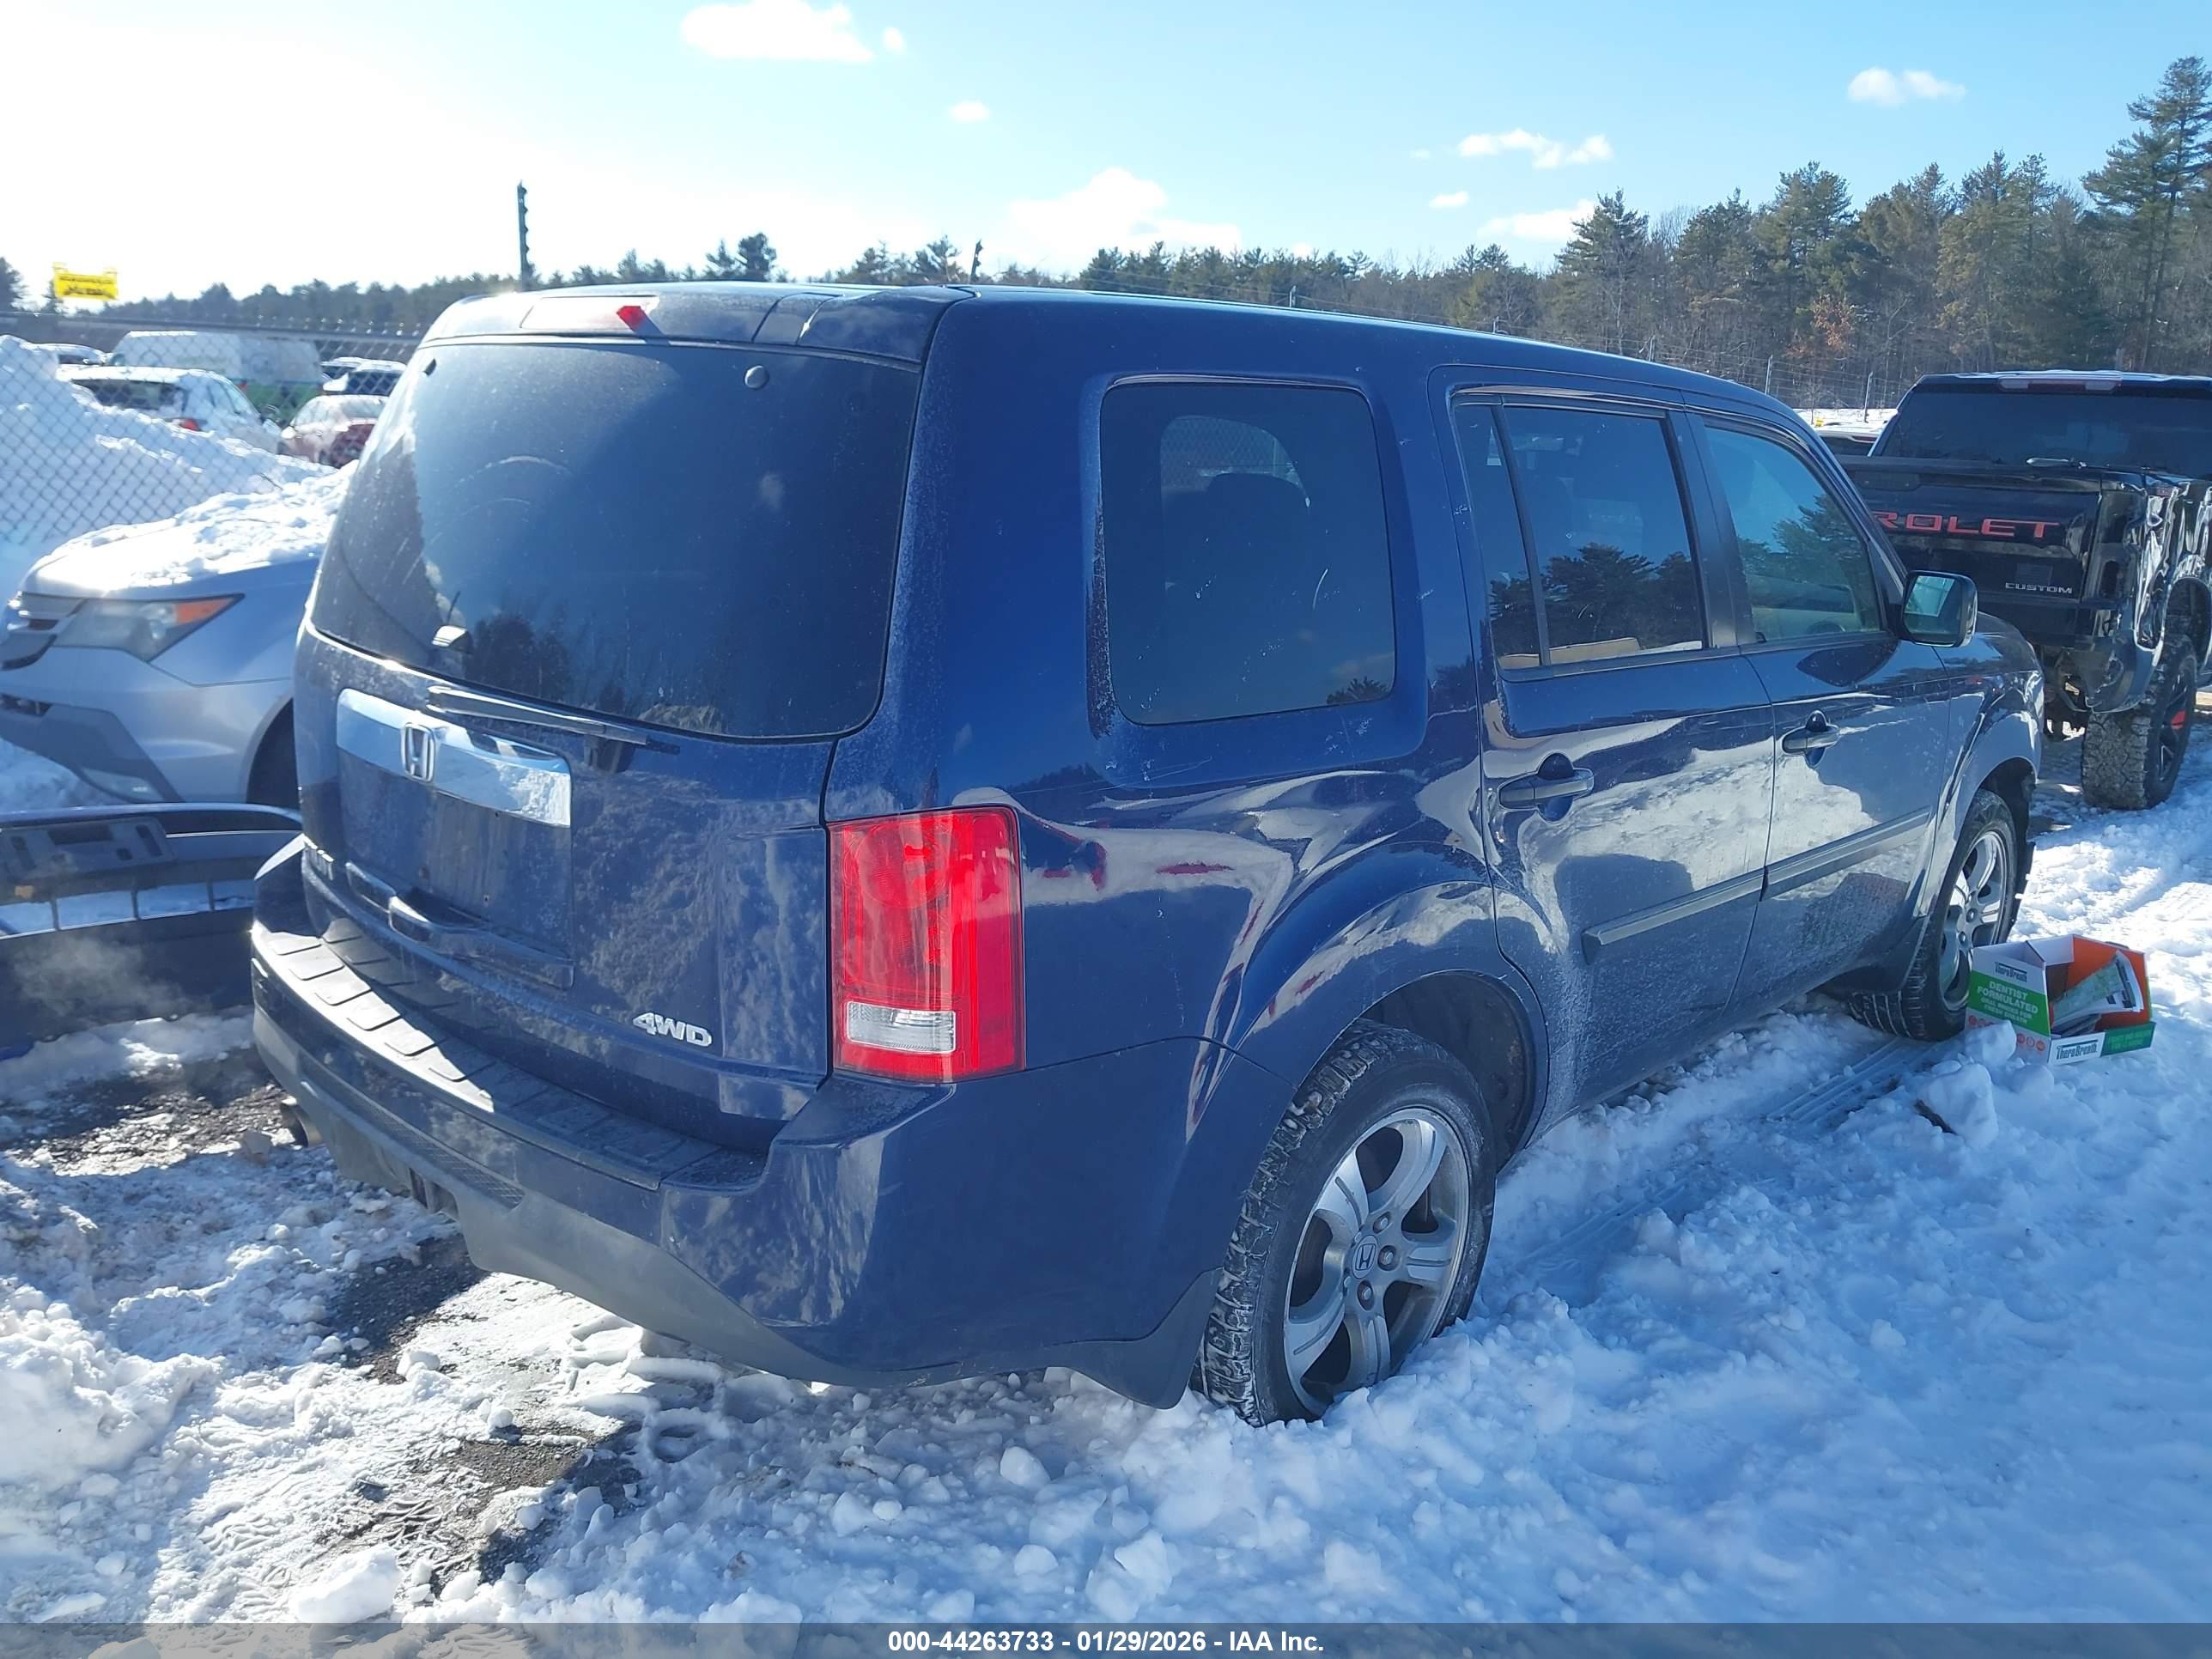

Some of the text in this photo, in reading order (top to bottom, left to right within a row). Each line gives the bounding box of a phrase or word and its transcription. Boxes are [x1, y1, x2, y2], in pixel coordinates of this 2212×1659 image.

[2005, 581, 2073, 594] CUSTOM
[1977, 986, 2039, 1013] FORMULATED
[1989, 981, 2028, 1000] DENTIST
[633, 1012, 712, 1047] 4WD
[2057, 1040, 2099, 1060] TheraBreath
